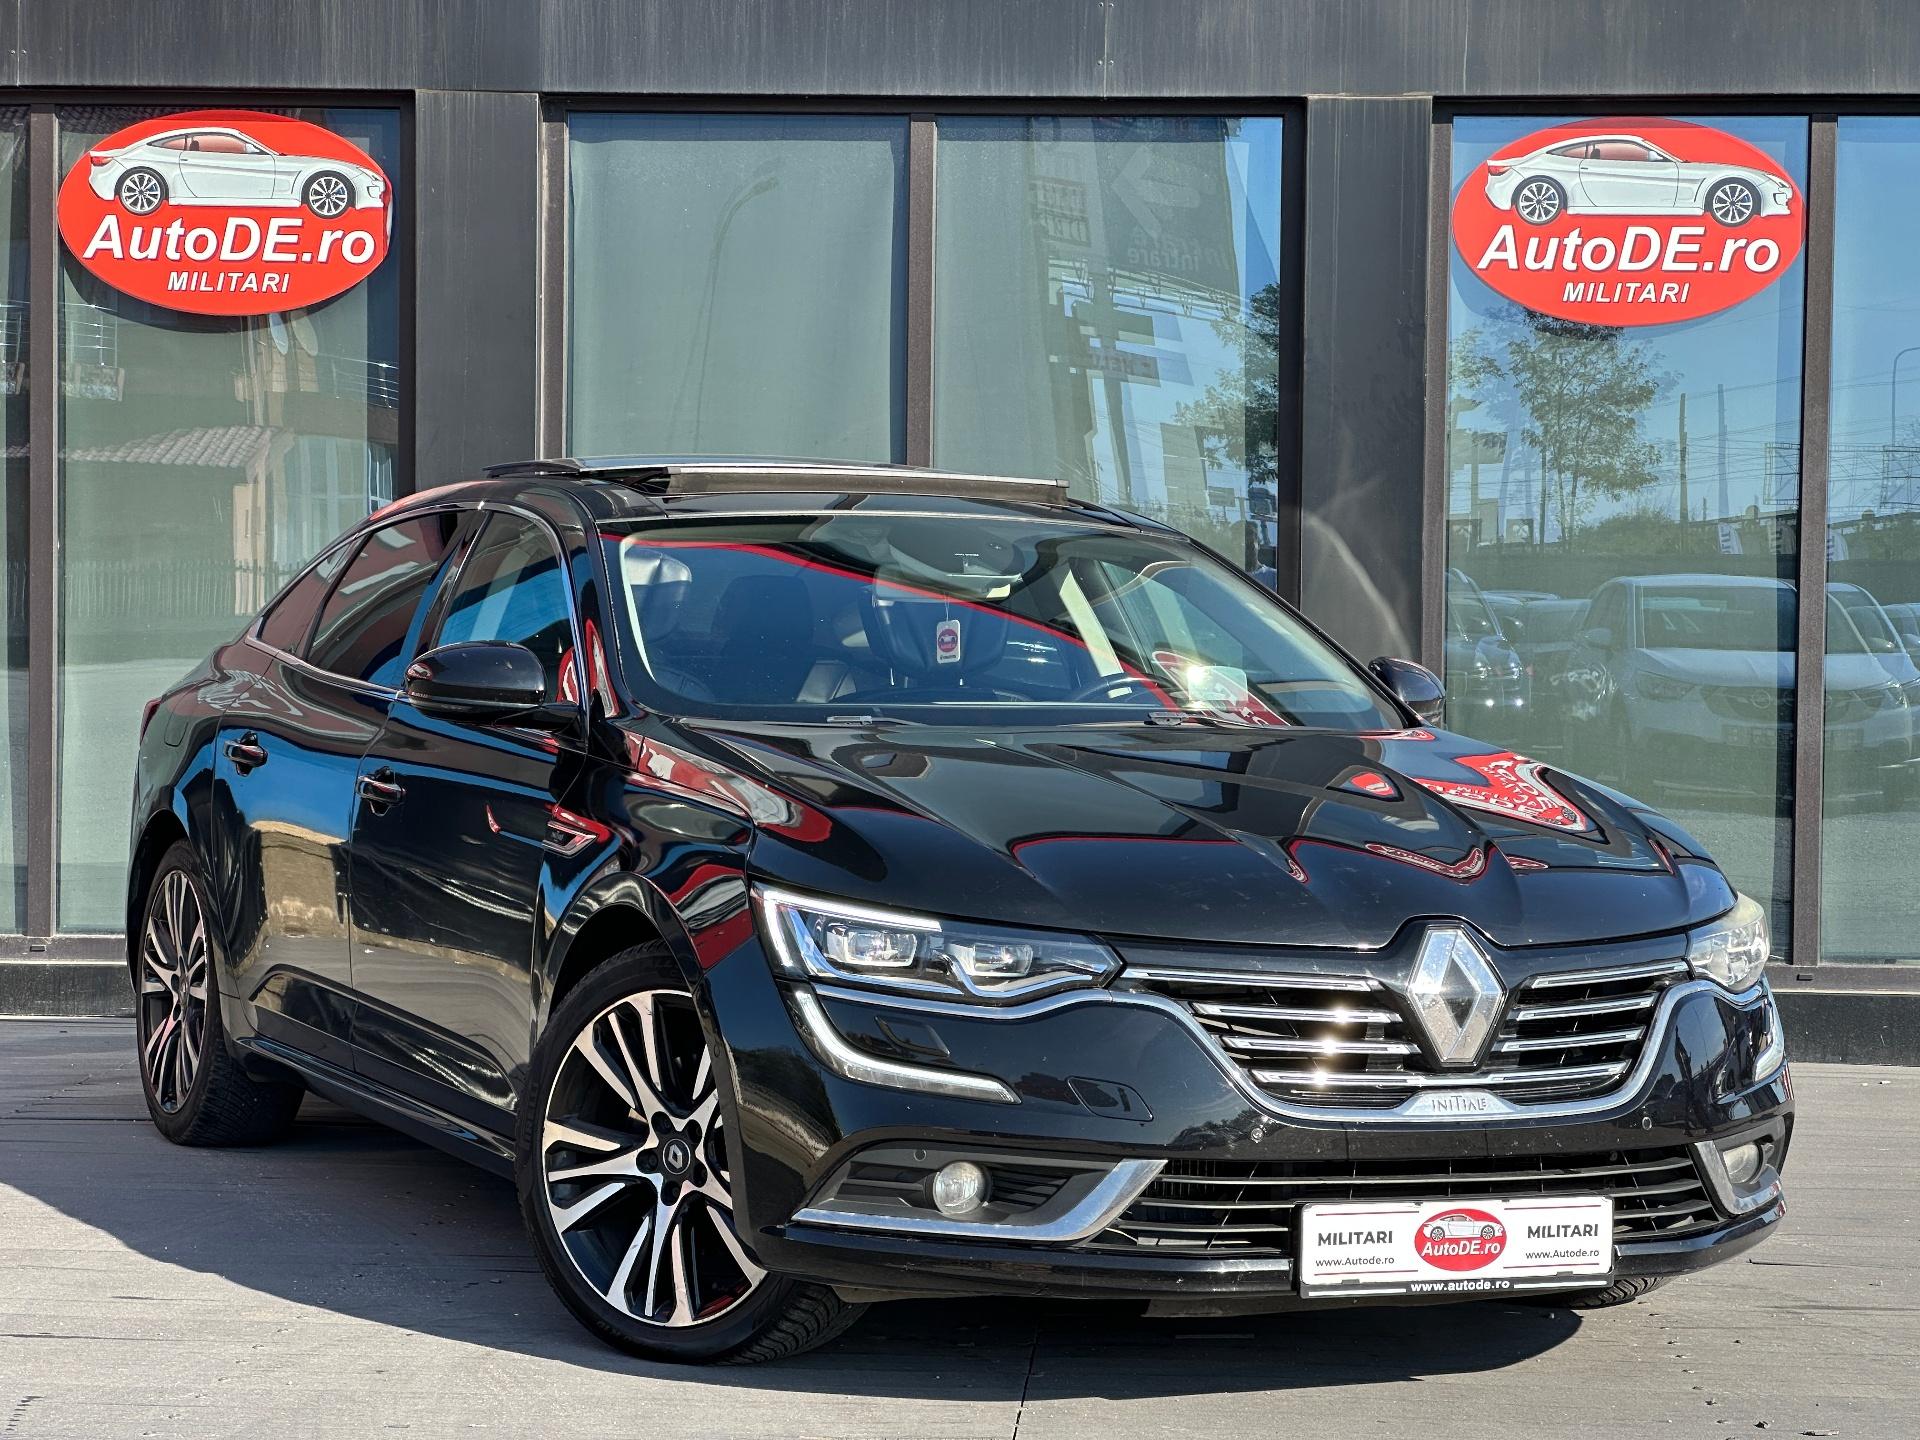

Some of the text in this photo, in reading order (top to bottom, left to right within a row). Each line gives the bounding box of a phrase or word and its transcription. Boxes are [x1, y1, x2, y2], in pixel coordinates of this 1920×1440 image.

[83, 214, 376, 265] AutoDE.ro
[1477, 224, 1780, 273] AutoDE.ro
[167, 271, 290, 294] MILITARI
[1562, 281, 1690, 304] MILITARI
[1431, 1095, 1487, 1112] INITIALE
[1317, 1230, 1393, 1247] MILITARI
[1527, 1223, 1599, 1239] MILITARI
[1421, 1240, 1501, 1257] AutoDE.ro
[1525, 1248, 1600, 1260] www.Autode.ro
[1315, 1255, 1395, 1267] www.Autode.ro
[1410, 1279, 1511, 1293] www.autode.ro
